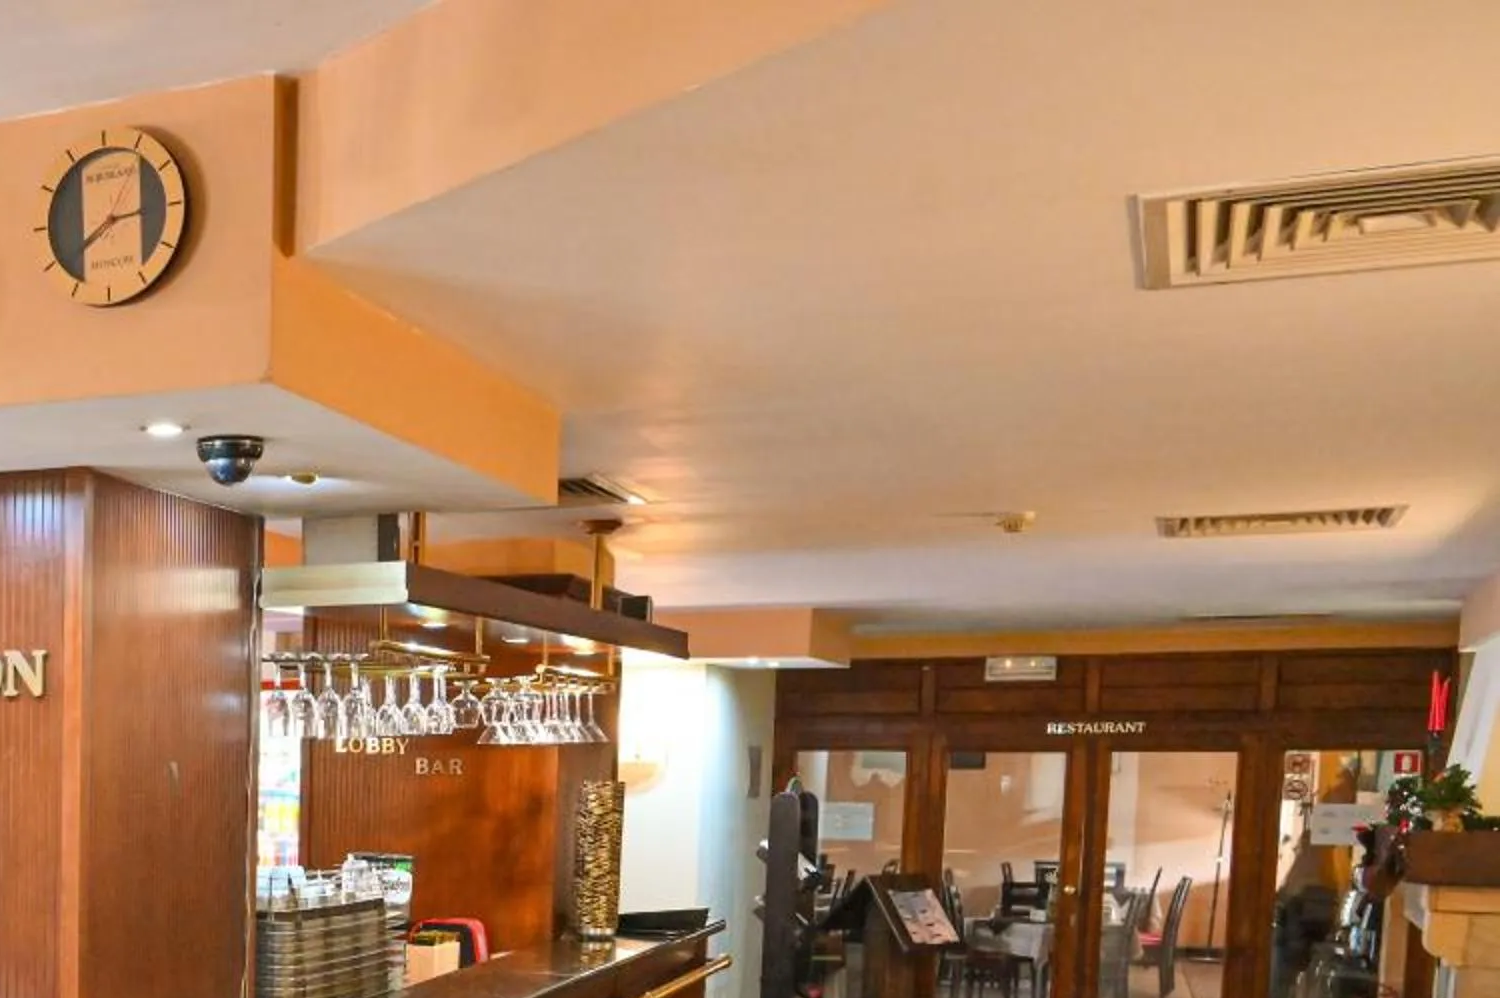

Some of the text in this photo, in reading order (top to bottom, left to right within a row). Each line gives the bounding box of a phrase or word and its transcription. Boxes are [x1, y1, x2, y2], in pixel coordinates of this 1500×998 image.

[1047, 721, 1146, 735] RESTAURANT
[335, 735, 409, 755] LOBBY
[415, 757, 463, 775] BAR
